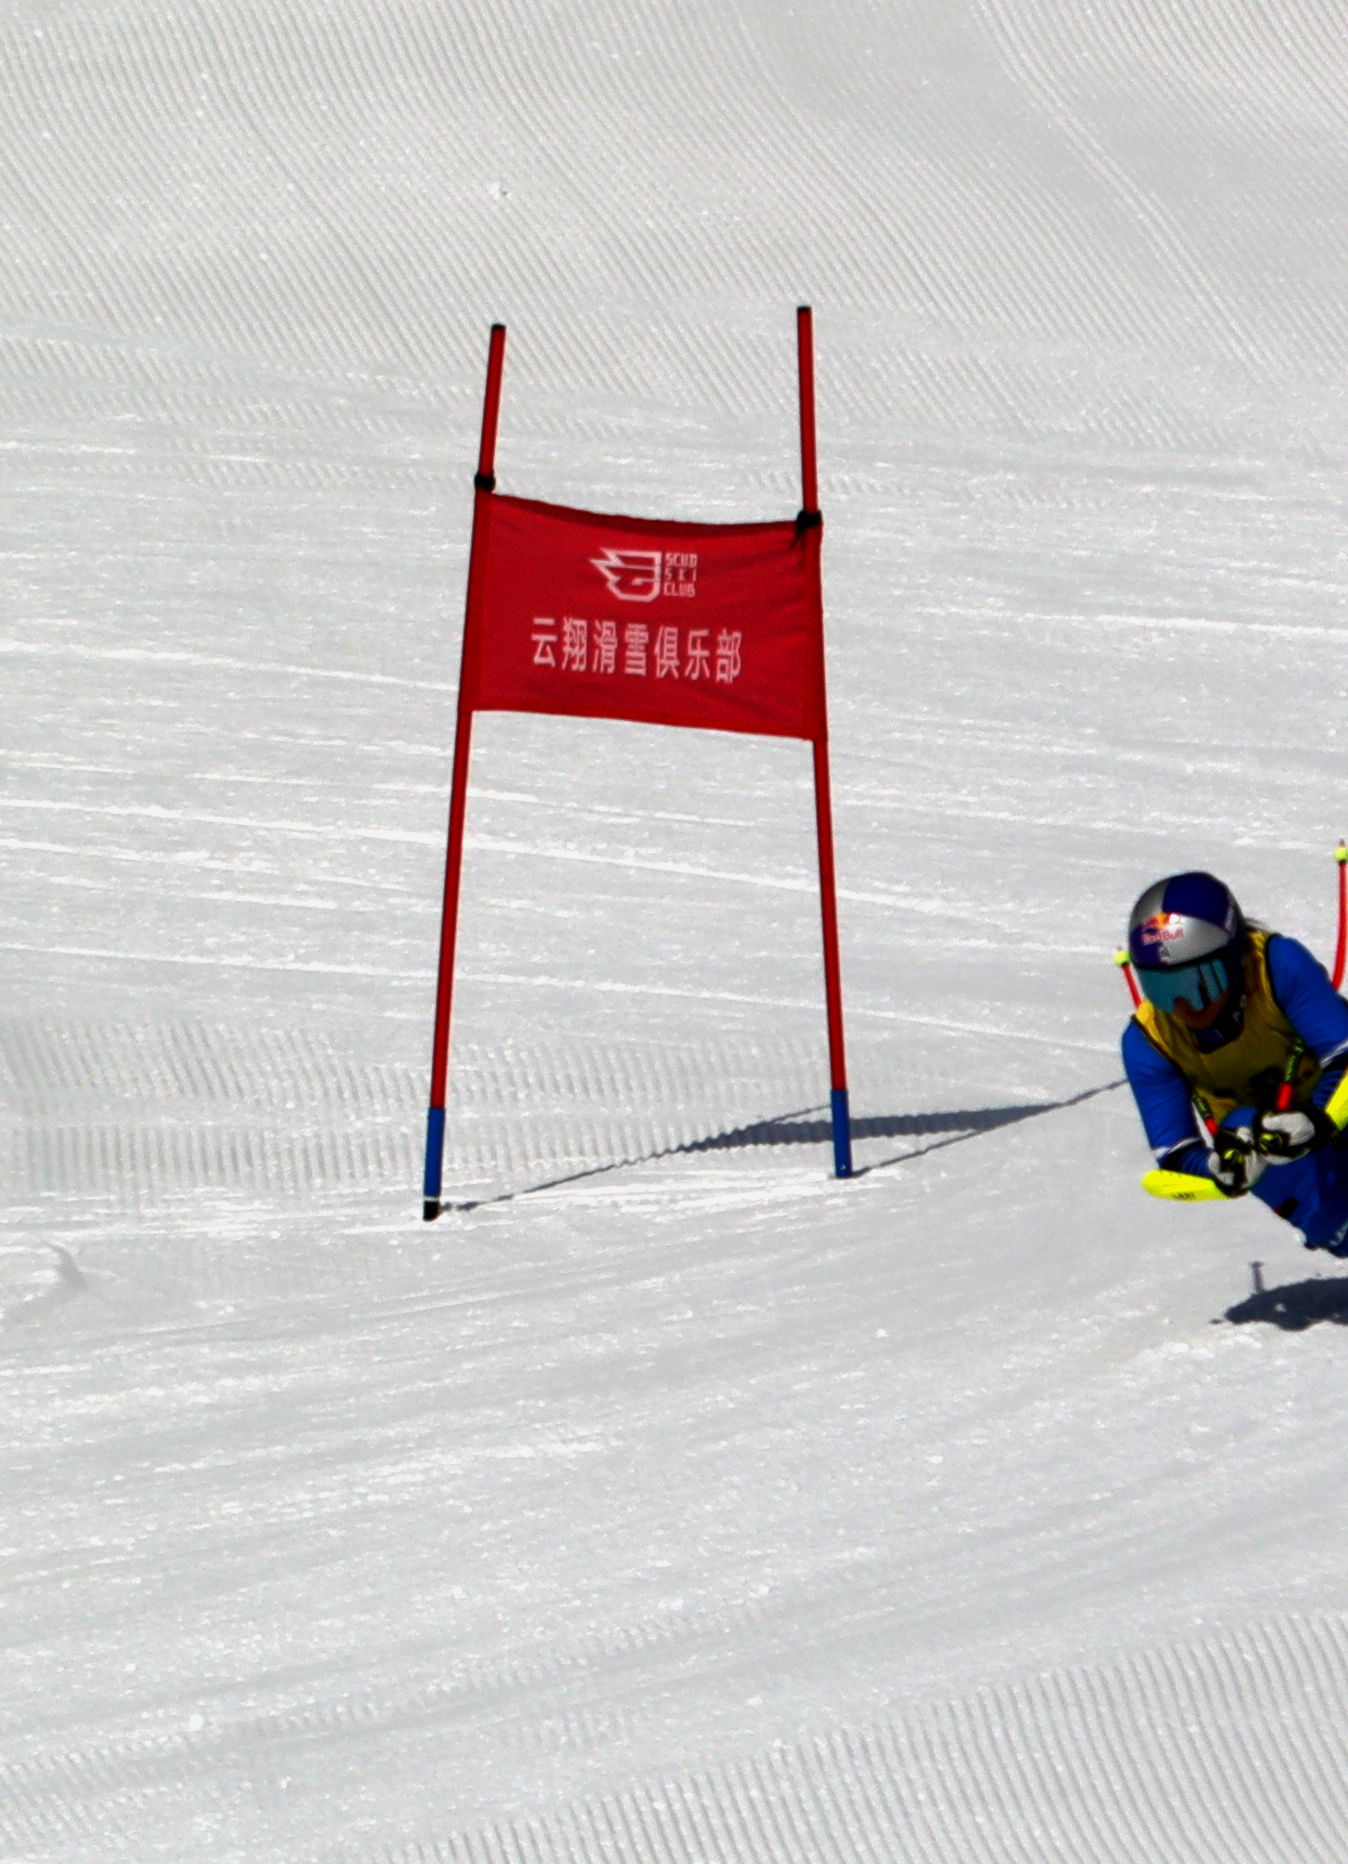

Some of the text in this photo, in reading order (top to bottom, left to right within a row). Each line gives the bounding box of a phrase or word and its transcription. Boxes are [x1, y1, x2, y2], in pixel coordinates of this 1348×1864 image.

[664, 567, 698, 582] SKI
[663, 582, 697, 598] CLUB
[530, 616, 743, 684] 云翔滑雪俱乐部
[1161, 929, 1184, 941] Bull
